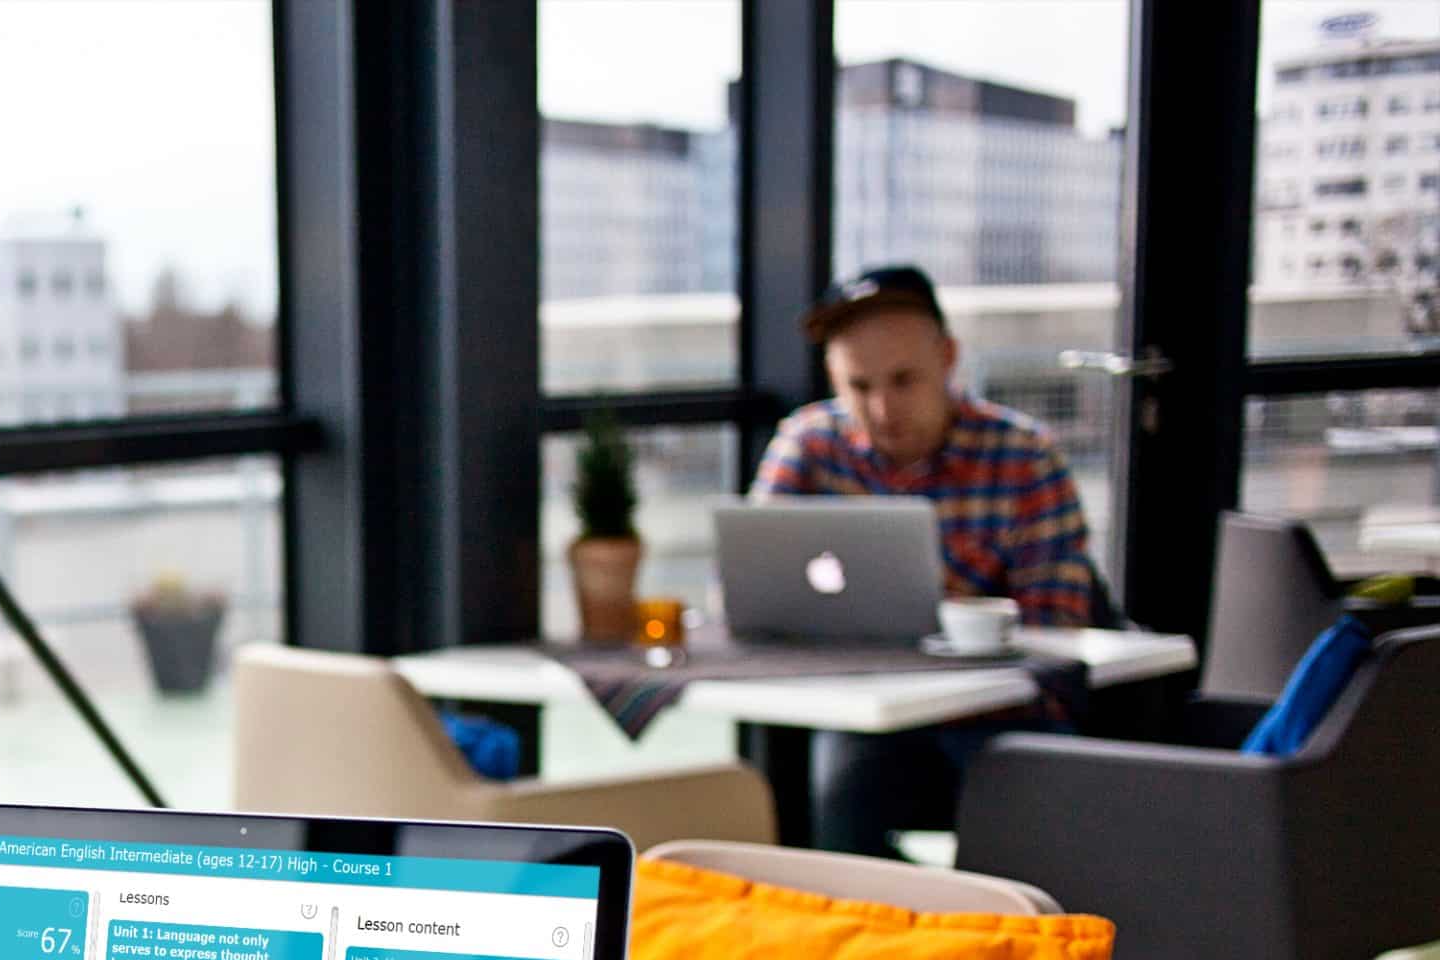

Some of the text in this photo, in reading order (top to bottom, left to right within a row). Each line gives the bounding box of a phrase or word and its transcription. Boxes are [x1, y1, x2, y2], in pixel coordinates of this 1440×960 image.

[61, 843, 105, 863] English
[110, 846, 193, 866] Intermediate
[197, 850, 234, 870] (ages
[239, 853, 283, 873] 12-17)
[287, 856, 318, 875] High
[333, 858, 380, 876] Course
[384, 862, 393, 876] 1
[119, 891, 170, 906] Lessons
[113, 925, 269, 949] Unit 1: Language not only
[357, 915, 461, 937] Lesson content
[111, 944, 151, 957] serves
[154, 945, 167, 957] to
